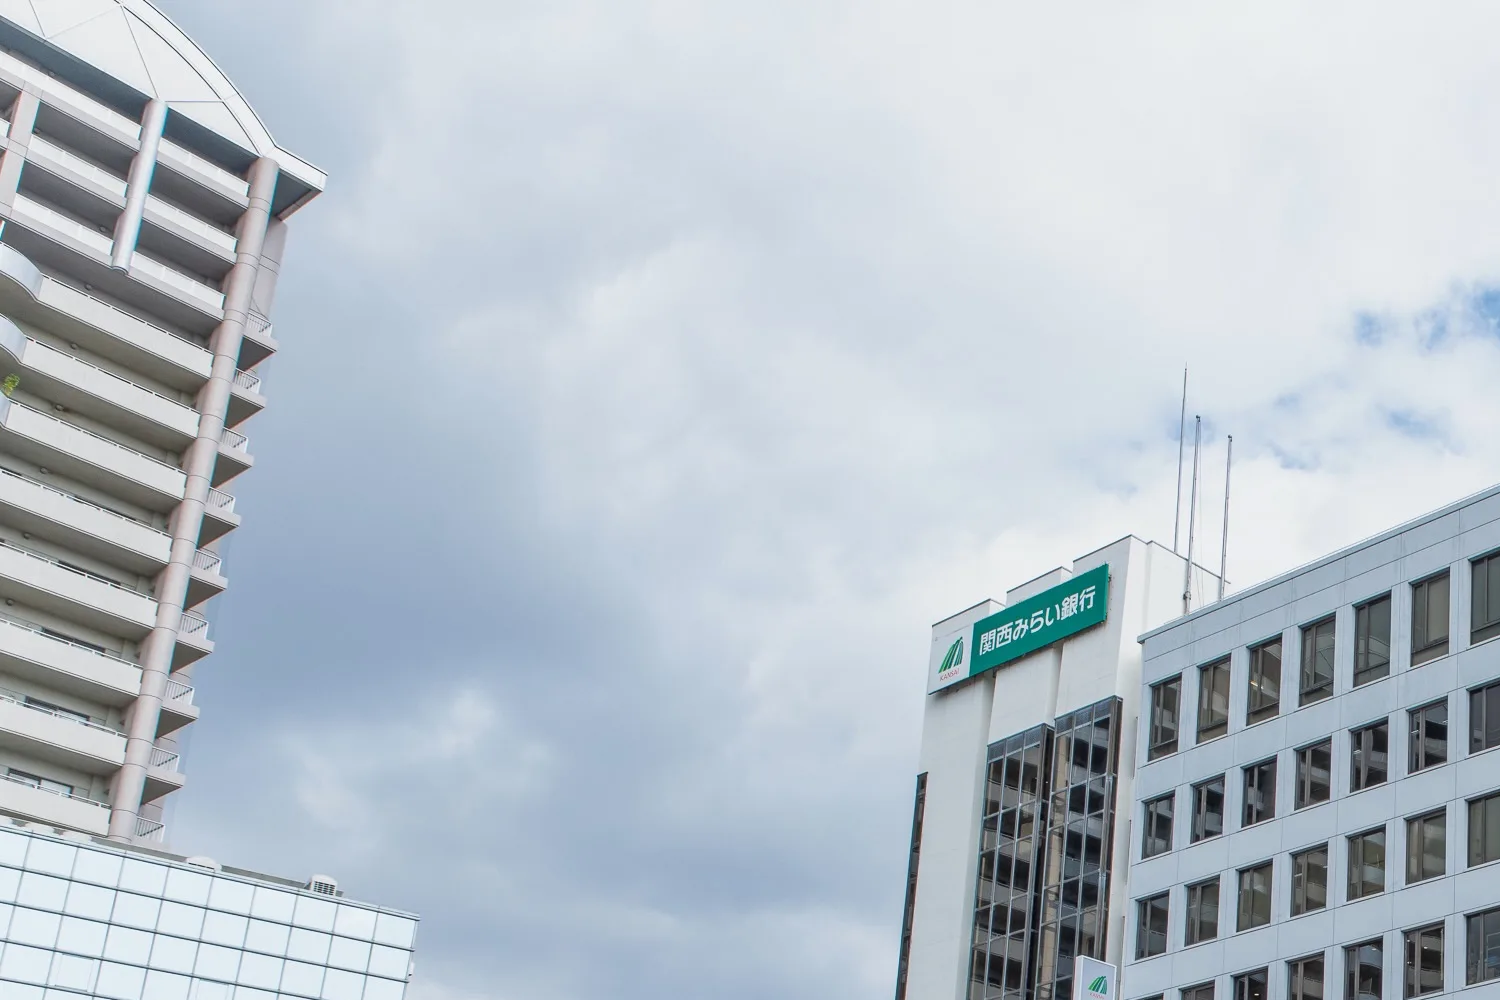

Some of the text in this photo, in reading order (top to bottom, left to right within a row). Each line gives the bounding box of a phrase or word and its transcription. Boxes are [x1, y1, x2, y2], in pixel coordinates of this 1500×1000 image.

[978, 585, 1096, 656] 関西みらい銀行
[939, 668, 960, 682] KANSAI
